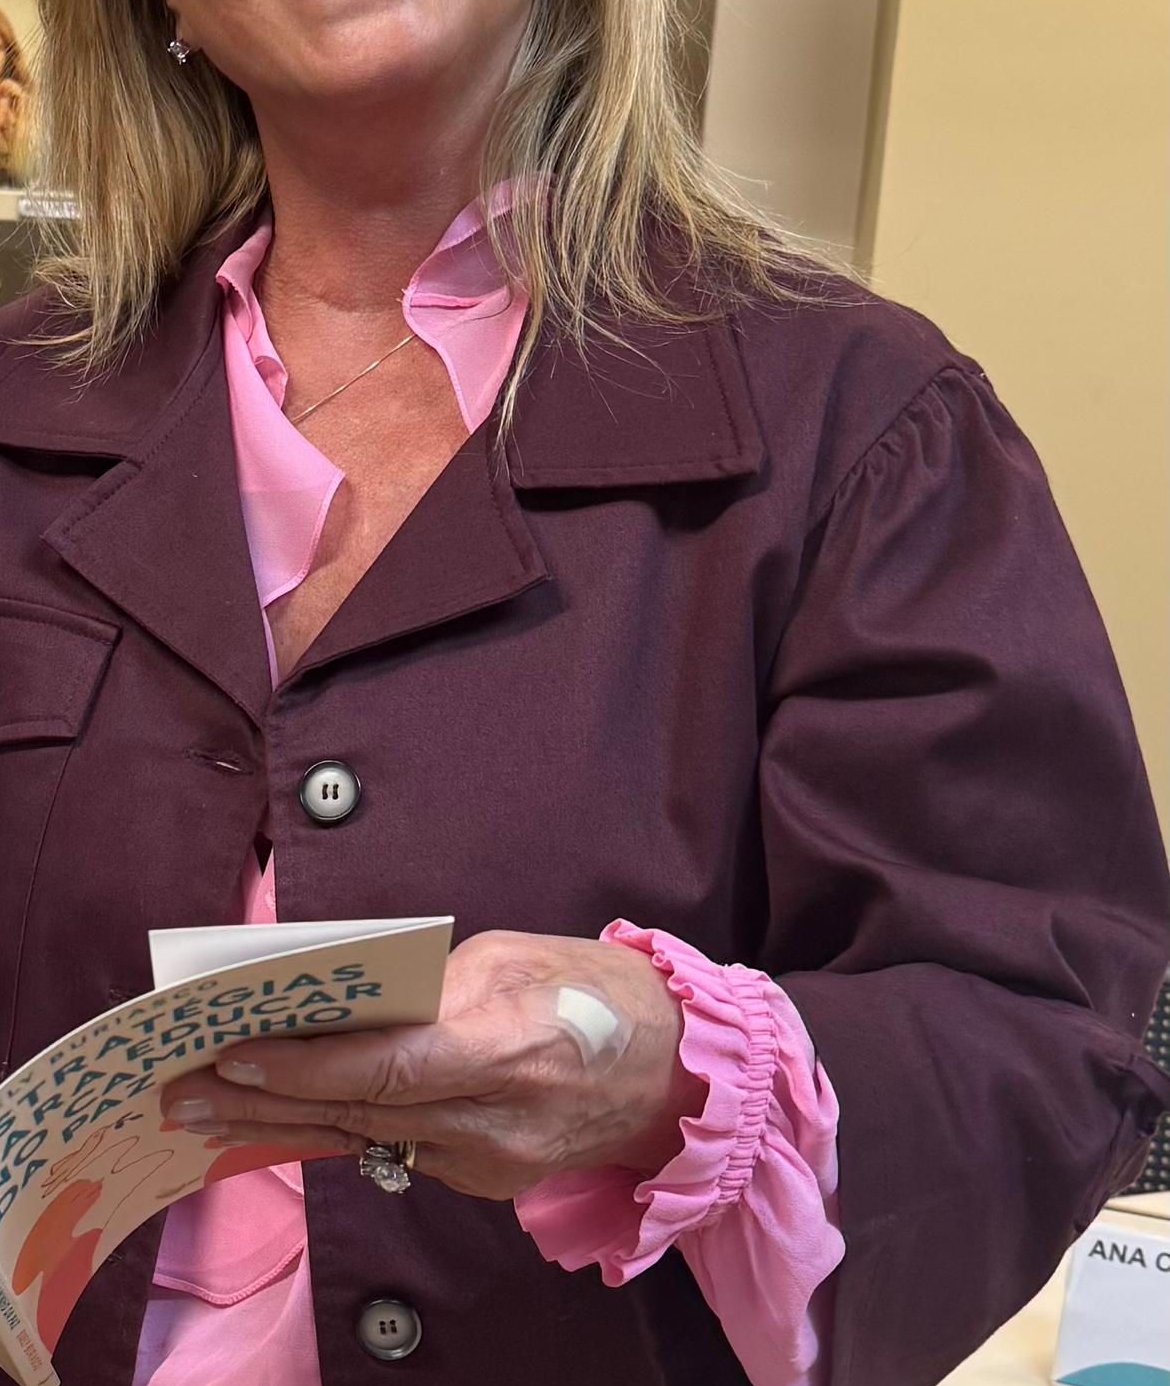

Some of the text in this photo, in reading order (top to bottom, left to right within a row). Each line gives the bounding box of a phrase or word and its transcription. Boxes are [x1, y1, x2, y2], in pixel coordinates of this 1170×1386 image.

[127, 982, 382, 1061] EDUCAR
[63, 1006, 352, 1118] CAMINHO
[62, 1072, 158, 1144] PAZ
[1088, 1239, 1147, 1268] ANA
